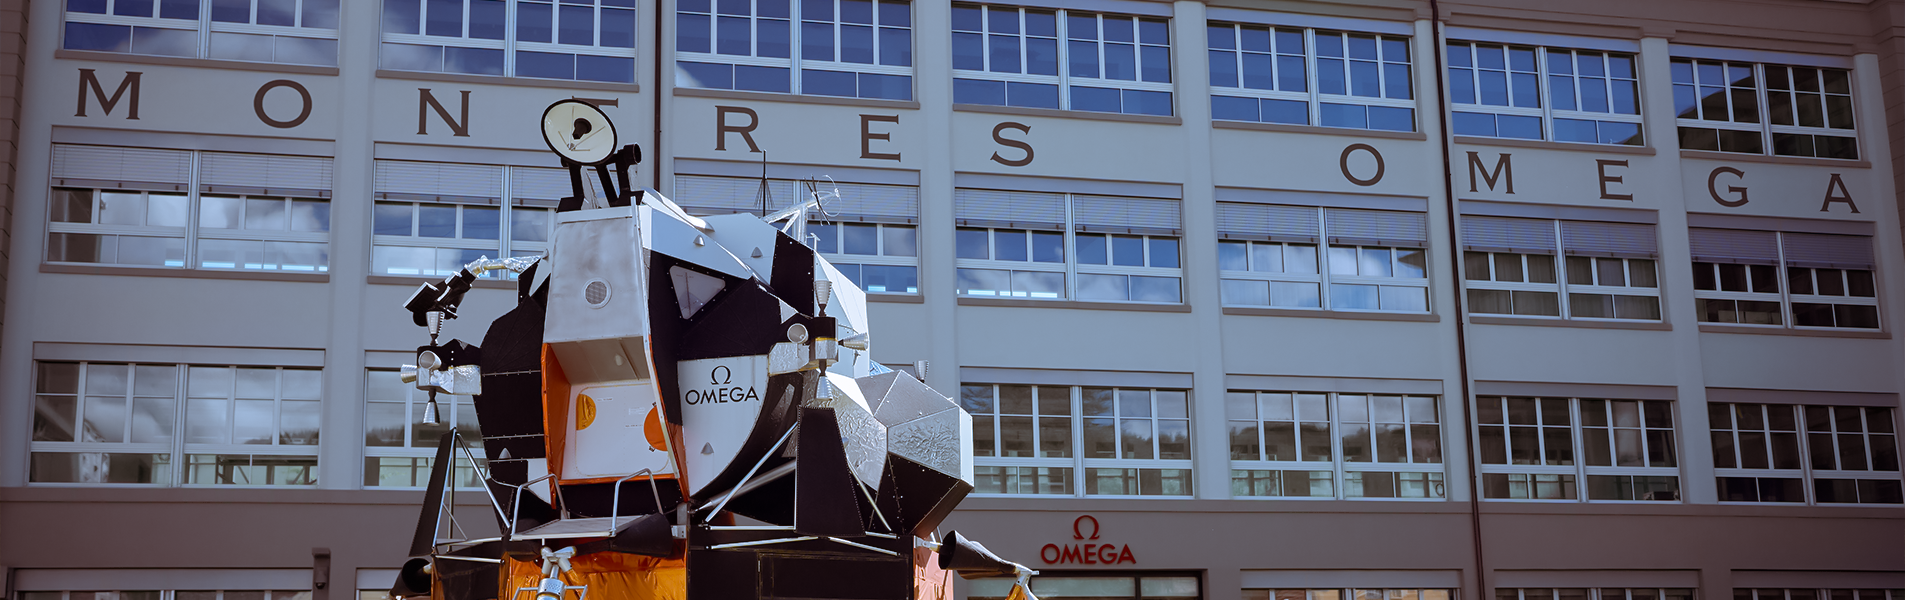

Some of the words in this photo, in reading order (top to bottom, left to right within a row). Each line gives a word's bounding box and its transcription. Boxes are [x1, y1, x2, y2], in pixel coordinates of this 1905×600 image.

[1340, 143, 1861, 214] OMEGA
[685, 386, 759, 405] OMEGA
[1040, 543, 1137, 565] OMEGA
